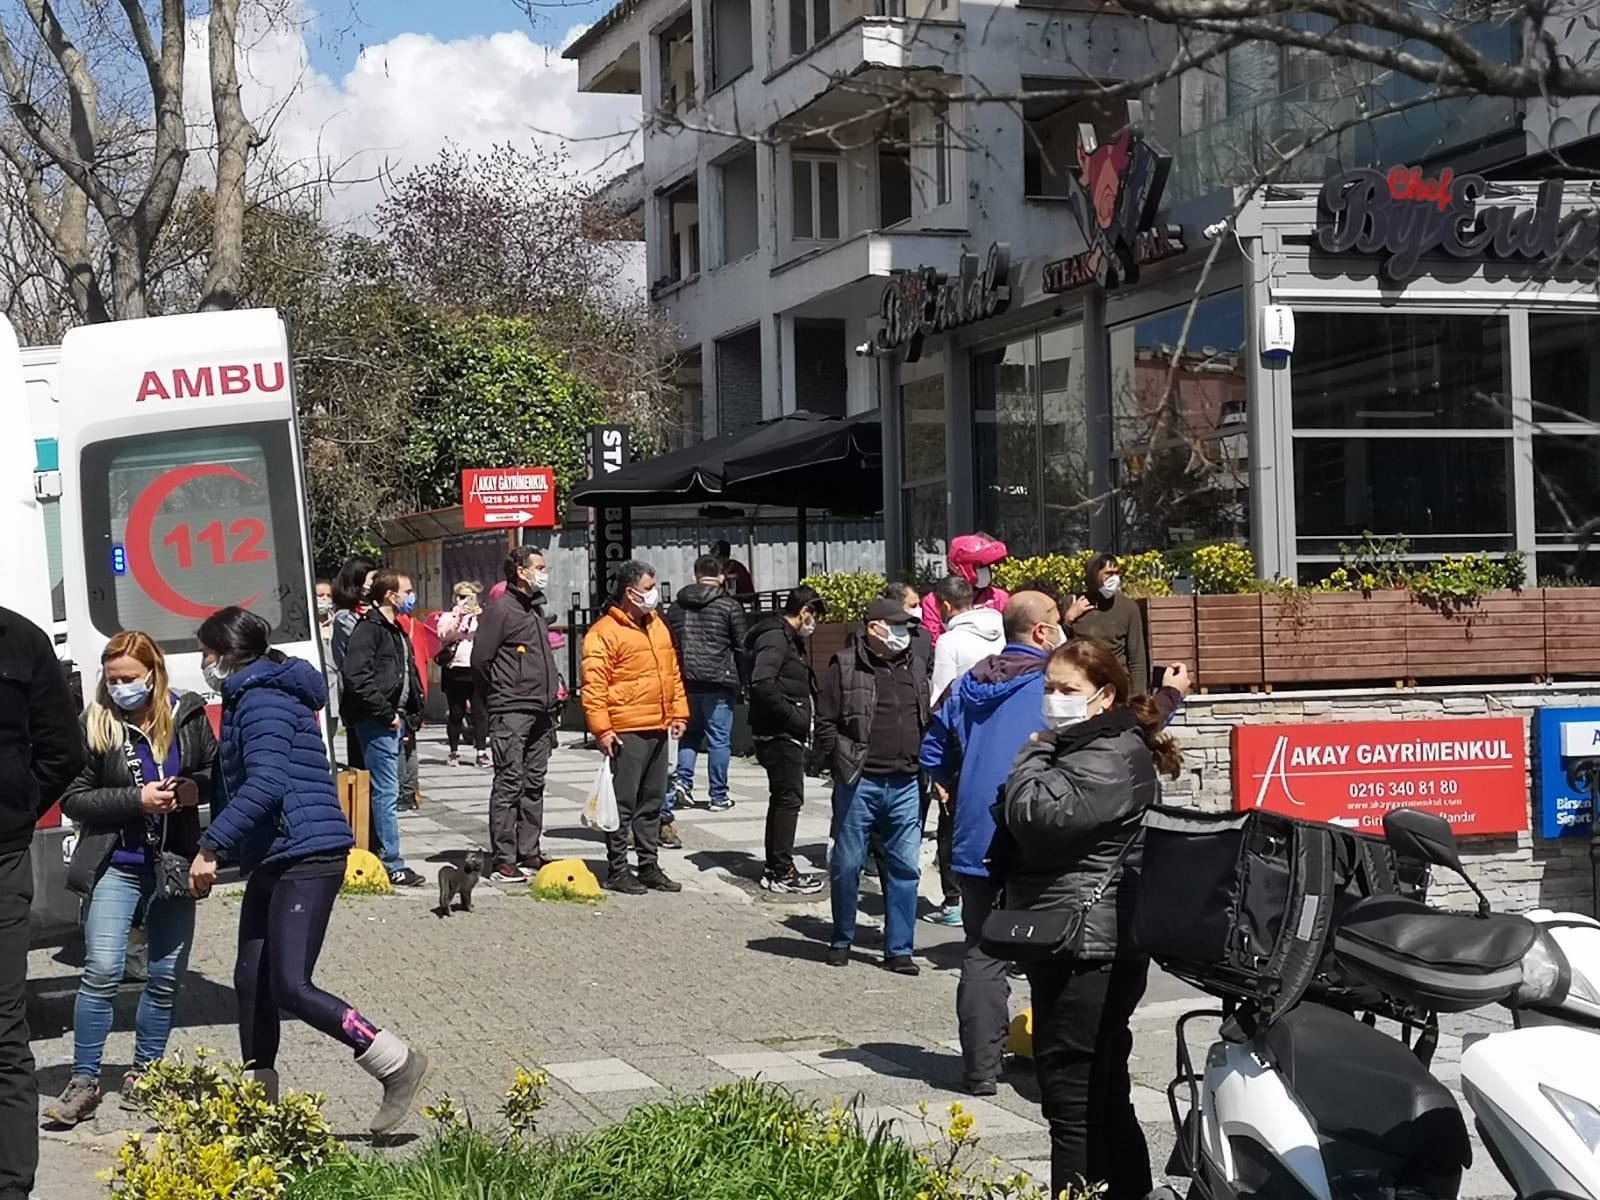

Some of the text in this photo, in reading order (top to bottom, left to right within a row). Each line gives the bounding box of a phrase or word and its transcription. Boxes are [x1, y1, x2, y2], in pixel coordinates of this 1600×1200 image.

[1387, 166, 1453, 212] Chef
[136, 362, 285, 402] AMBU
[163, 518, 270, 568] 112
[1290, 745, 1350, 767] AKAY
[1356, 738, 1513, 764] GAYRİMENKUL
[1349, 780, 1458, 798] 0216 340 81 80
[1556, 797, 1592, 810] Birsen
[1362, 814, 1384, 827] Giri
[1556, 812, 1592, 826] Sigort
